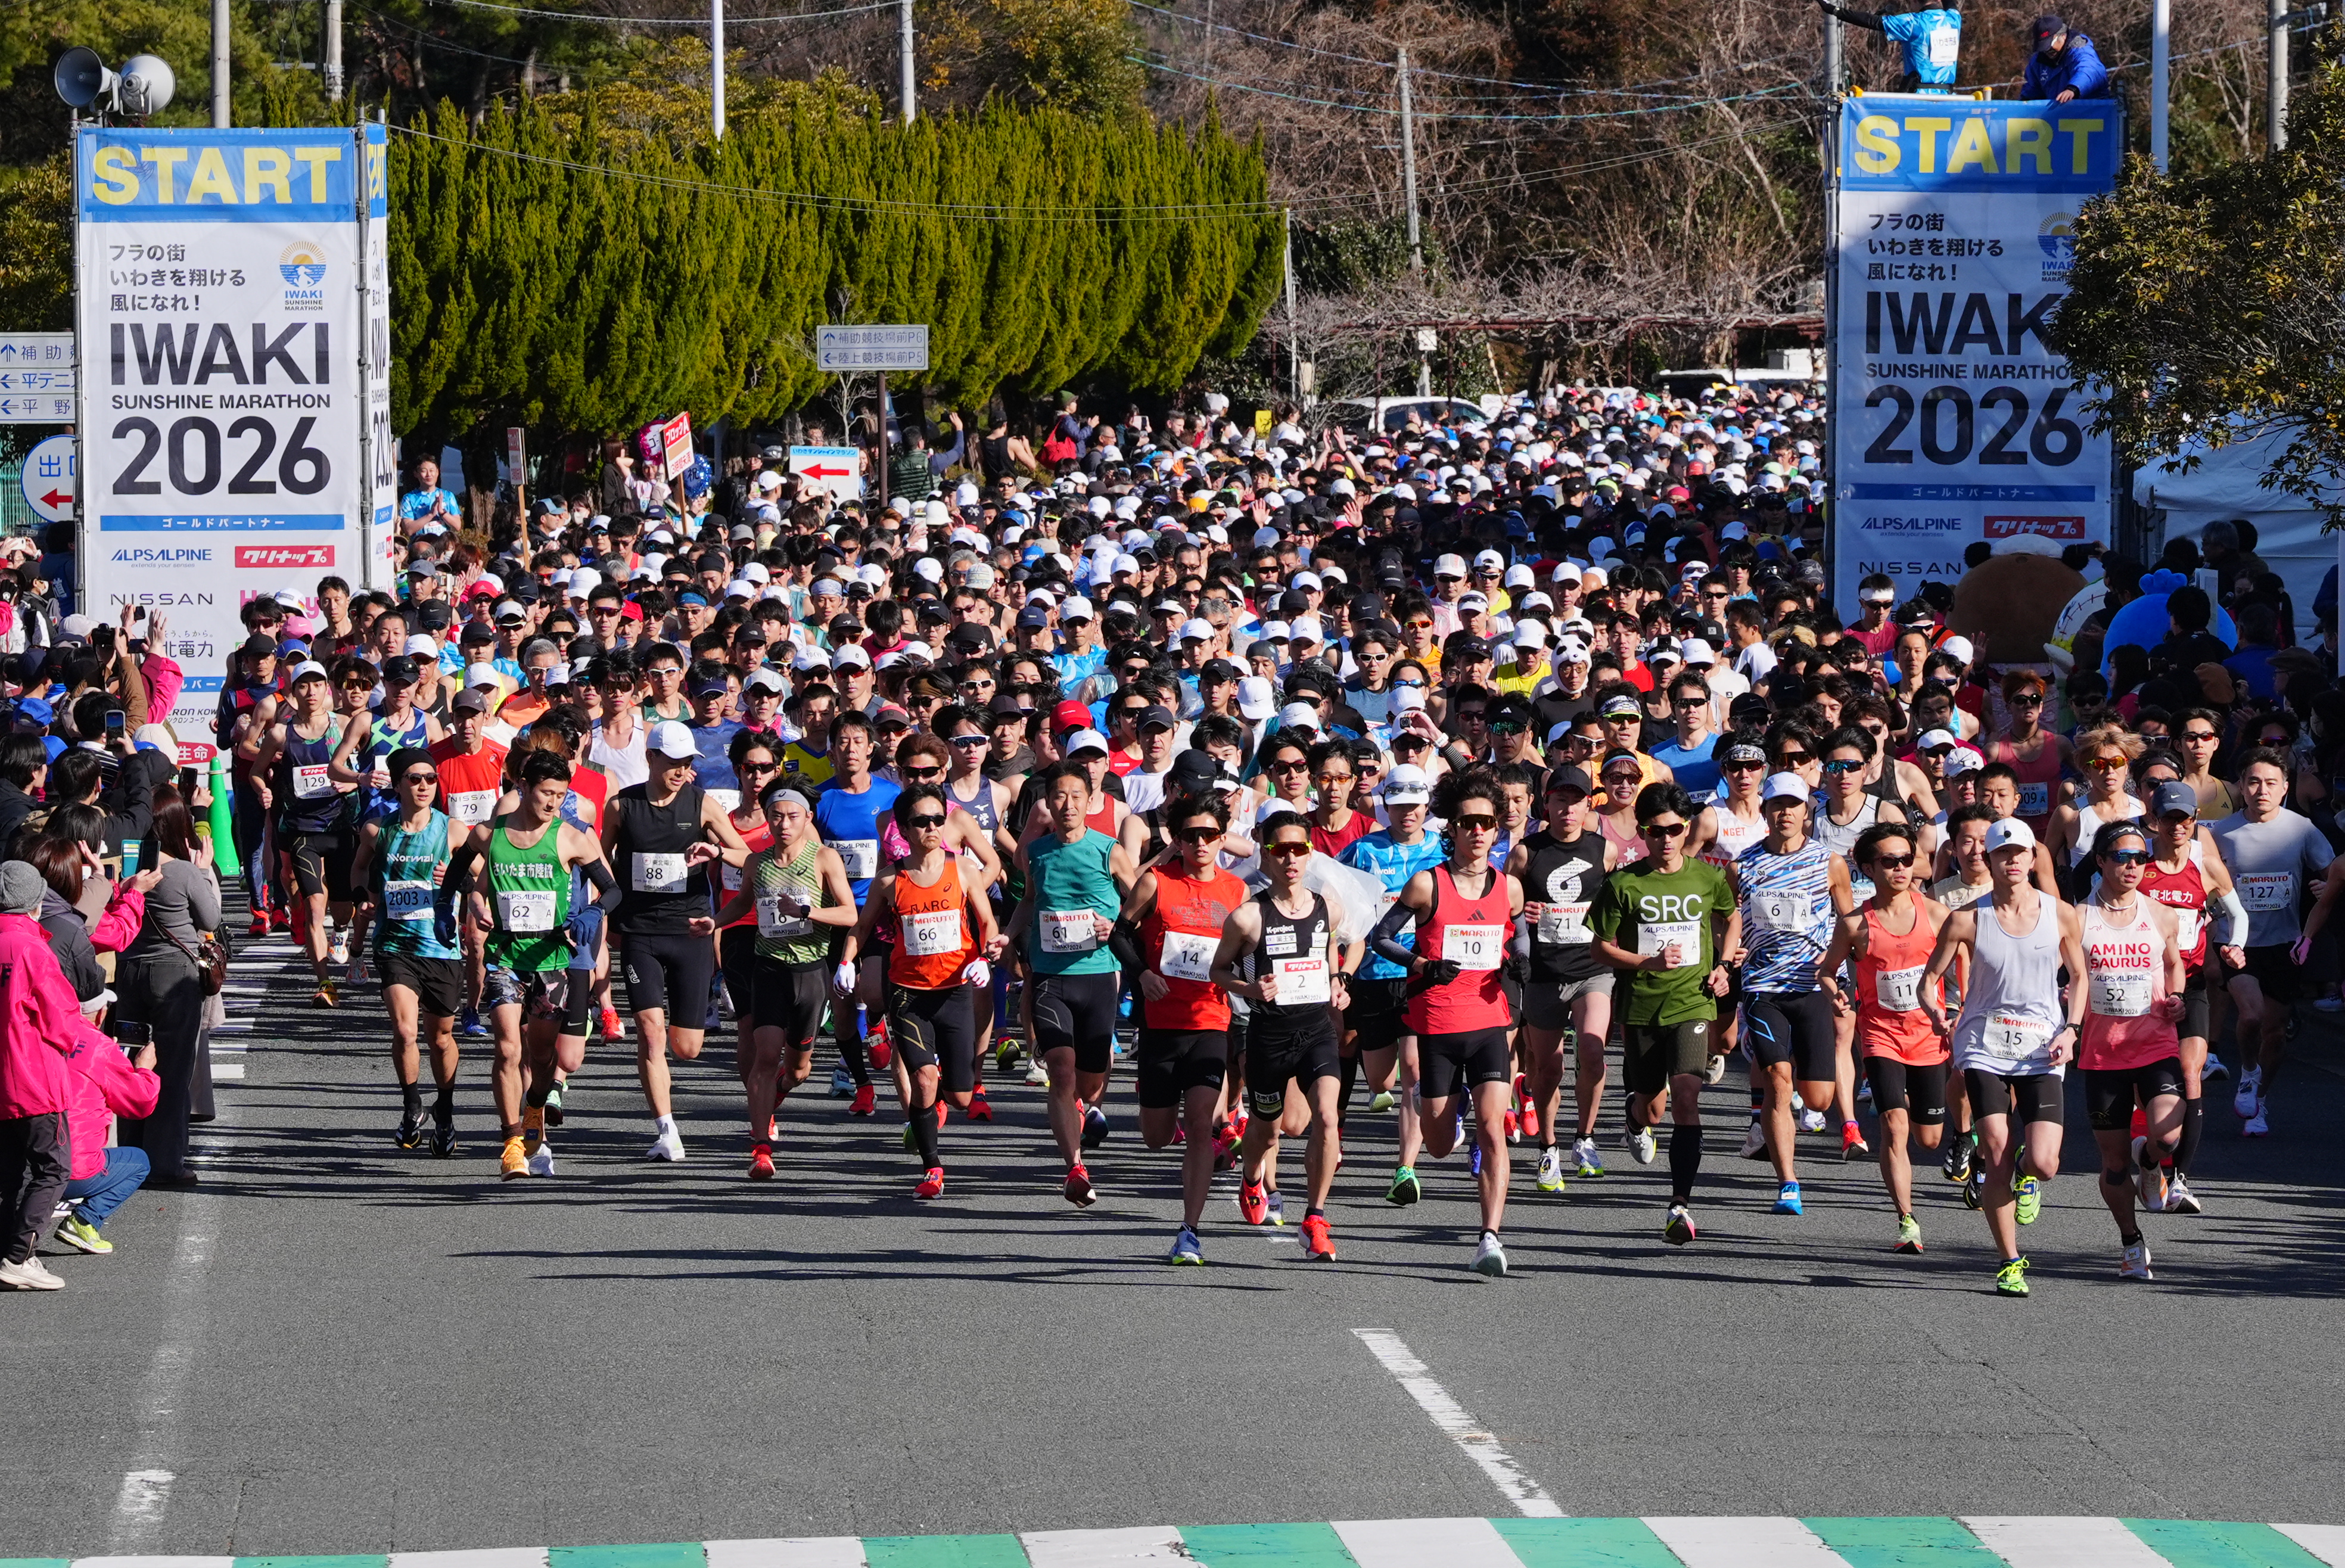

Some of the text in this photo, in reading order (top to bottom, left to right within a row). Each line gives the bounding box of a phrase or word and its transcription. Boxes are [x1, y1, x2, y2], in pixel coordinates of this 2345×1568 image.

[1855, 115, 2104, 175] START
[92, 147, 341, 205] START
[1868, 213, 1945, 232] フラの街
[109, 244, 185, 262] フラの街
[1868, 239, 2004, 257] いわきを翔ける
[2042, 261, 2076, 270] IWAK
[111, 269, 245, 287] いわきを翔ける
[1867, 263, 1957, 282] 風になれ！
[285, 290, 323, 298] IWAKI
[110, 294, 200, 312] 風になれ！
[1866, 291, 2070, 356] IWAK
[21, 345, 74, 360] 補助
[111, 322, 329, 385] IWAKI
[1865, 363, 1967, 378] SUNSHINE
[22, 373, 74, 389] 平テニ
[112, 394, 331, 409] SUNSHINE MARATHON
[1864, 384, 2083, 466] 2026
[111, 416, 331, 495] 2026
[688, 467, 700, 482] 祝
[1912, 487, 2035, 498] ゴールドパートナー
[162, 517, 285, 529] ゴールドパートナー
[1859, 561, 1961, 575] NISSAN
[111, 593, 213, 605] NISSAN
[163, 640, 213, 658] 北電力
[304, 776, 325, 788] 129
[450, 793, 494, 803] NISSAN
[462, 804, 477, 815] 79
[1723, 827, 1746, 837] NGET
[869, 857, 874, 865] A
[493, 862, 553, 879] さいたま市陸協
[646, 867, 685, 880] 88 A
[388, 891, 430, 906] 2003 A
[2148, 888, 2193, 903] 東北電力
[2248, 886, 2290, 898] 127 A
[512, 906, 552, 918] 62 A
[1640, 894, 1703, 922] SRC
[1771, 904, 1807, 918] 6 A
[770, 911, 787, 924] 16
[915, 915, 954, 925] MARUTO
[1050, 914, 1088, 922] MARUTO
[1554, 918, 1570, 930] 71
[919, 928, 957, 941] 66 A
[1052, 926, 1093, 939] 61 A
[1266, 925, 1295, 934] K-project
[2187, 926, 2192, 935] A
[1463, 941, 1499, 954] 10 A
[1692, 941, 1697, 950] A
[2089, 943, 2151, 956] AMINO
[1182, 950, 1199, 965] 14
[2091, 957, 2151, 969] SAURUS
[1881, 968, 1926, 981] ALPSALPIN
[1297, 975, 1306, 988] 2
[1895, 984, 1912, 997] 11
[2106, 988, 2149, 1001] 52 A
[2002, 1018, 2044, 1031] MARUTO
[2005, 1031, 2046, 1048] 15 A
